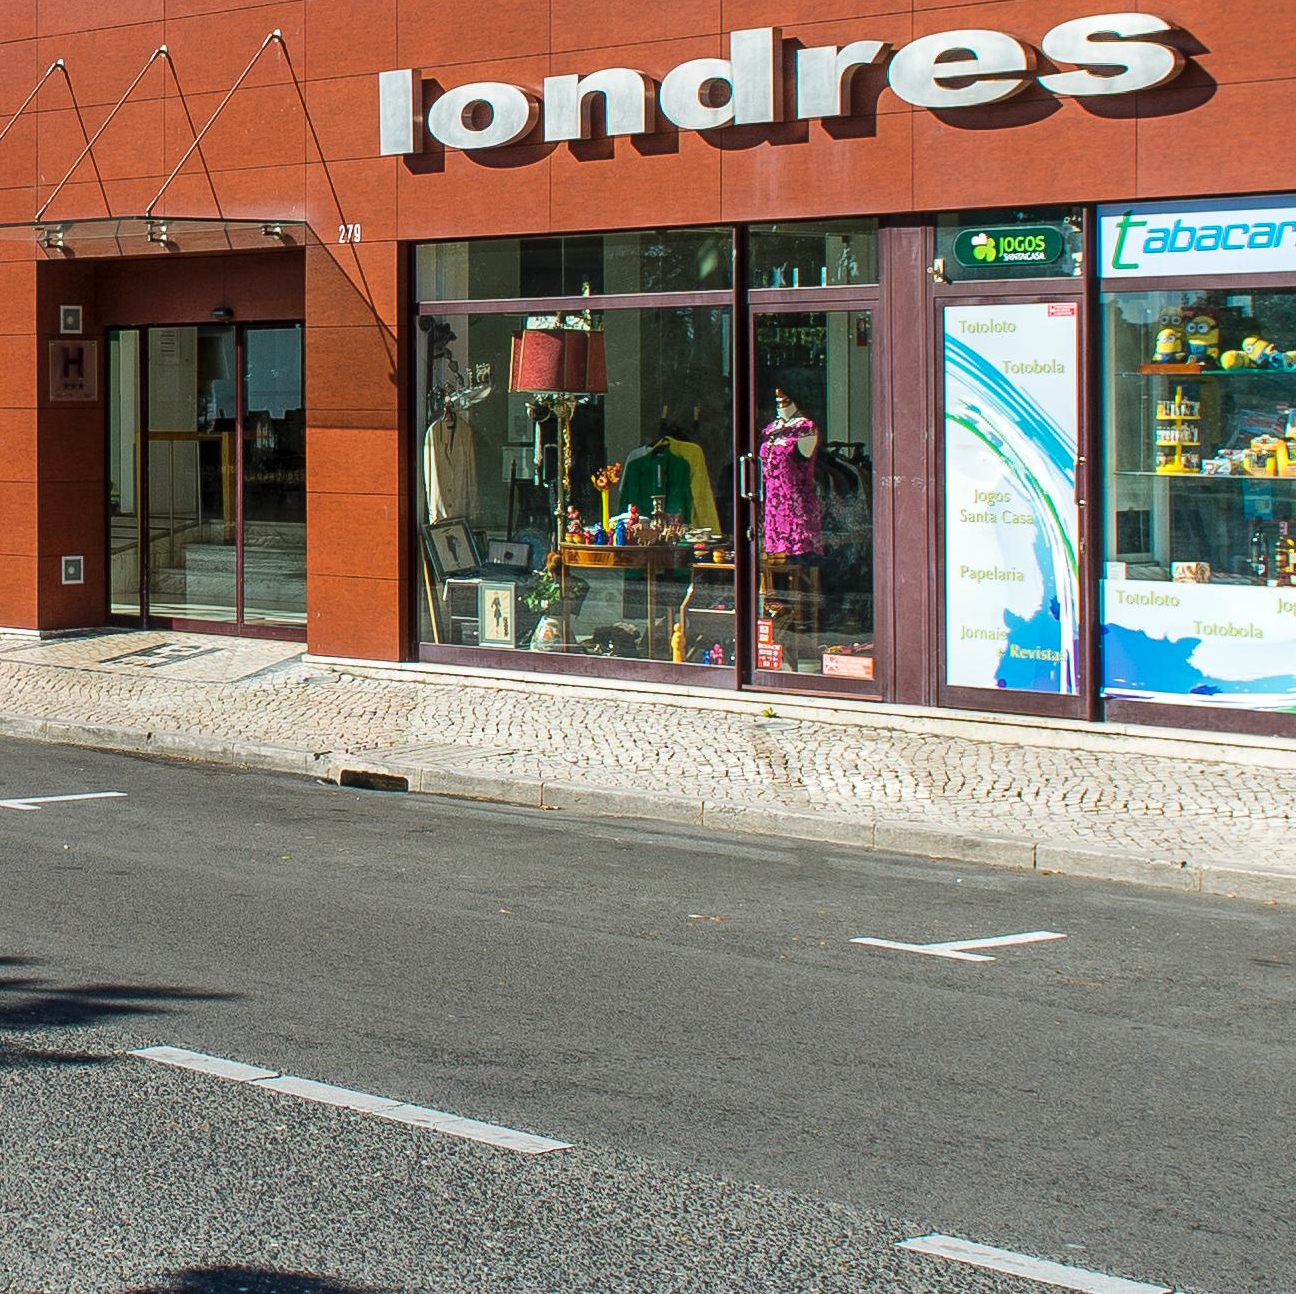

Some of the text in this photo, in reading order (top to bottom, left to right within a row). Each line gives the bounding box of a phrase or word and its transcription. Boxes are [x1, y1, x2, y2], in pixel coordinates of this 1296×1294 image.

[379, 12, 1183, 156] londres
[338, 223, 361, 244] 279
[998, 235, 1046, 258] JOGOS
[959, 319, 1016, 334] Totoloto
[63, 347, 85, 378] H
[1002, 359, 1065, 374] Totobola
[974, 489, 1011, 506] Jogos
[960, 509, 1035, 525] Santa Casa
[960, 565, 1025, 583] Papelaria
[1116, 590, 1180, 607] Totoloto
[960, 625, 1008, 641] Jornais
[1193, 620, 1264, 639] Totobola
[1010, 642, 1067, 662] Revistas
